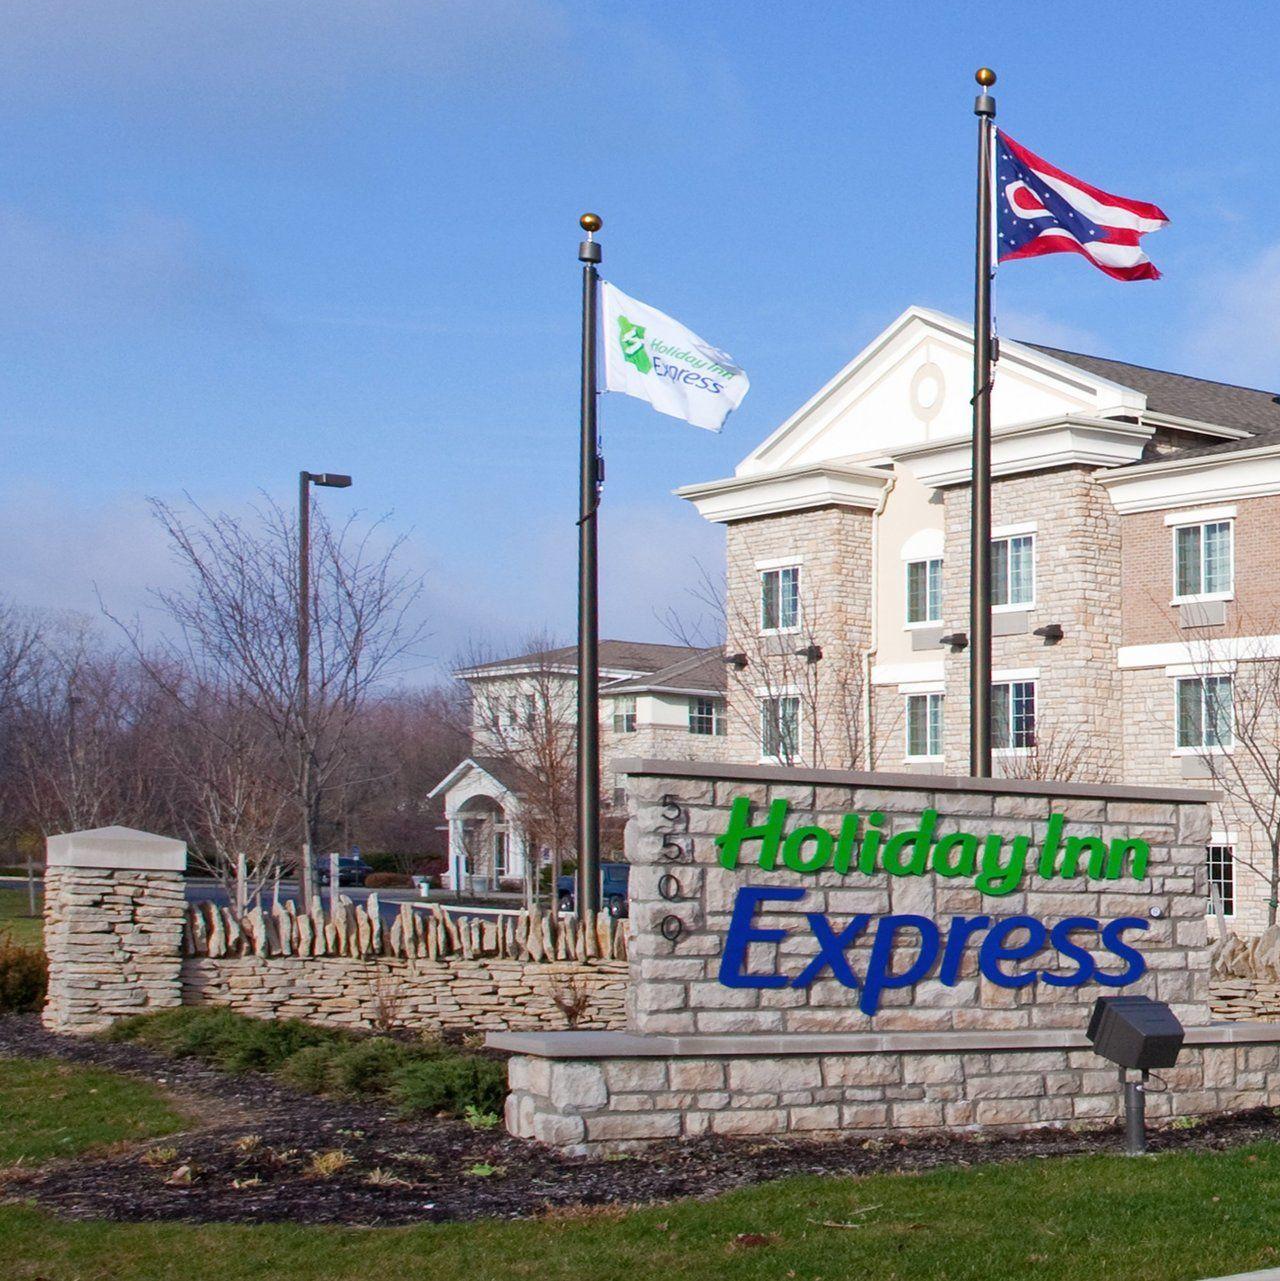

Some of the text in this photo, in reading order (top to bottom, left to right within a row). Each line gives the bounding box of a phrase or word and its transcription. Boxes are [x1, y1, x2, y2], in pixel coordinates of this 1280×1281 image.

[651, 338, 735, 380] Holiday Inn
[658, 794, 682, 941] 5500
[714, 797, 1150, 896] Holiday Inn
[718, 886, 1149, 1017] Express
